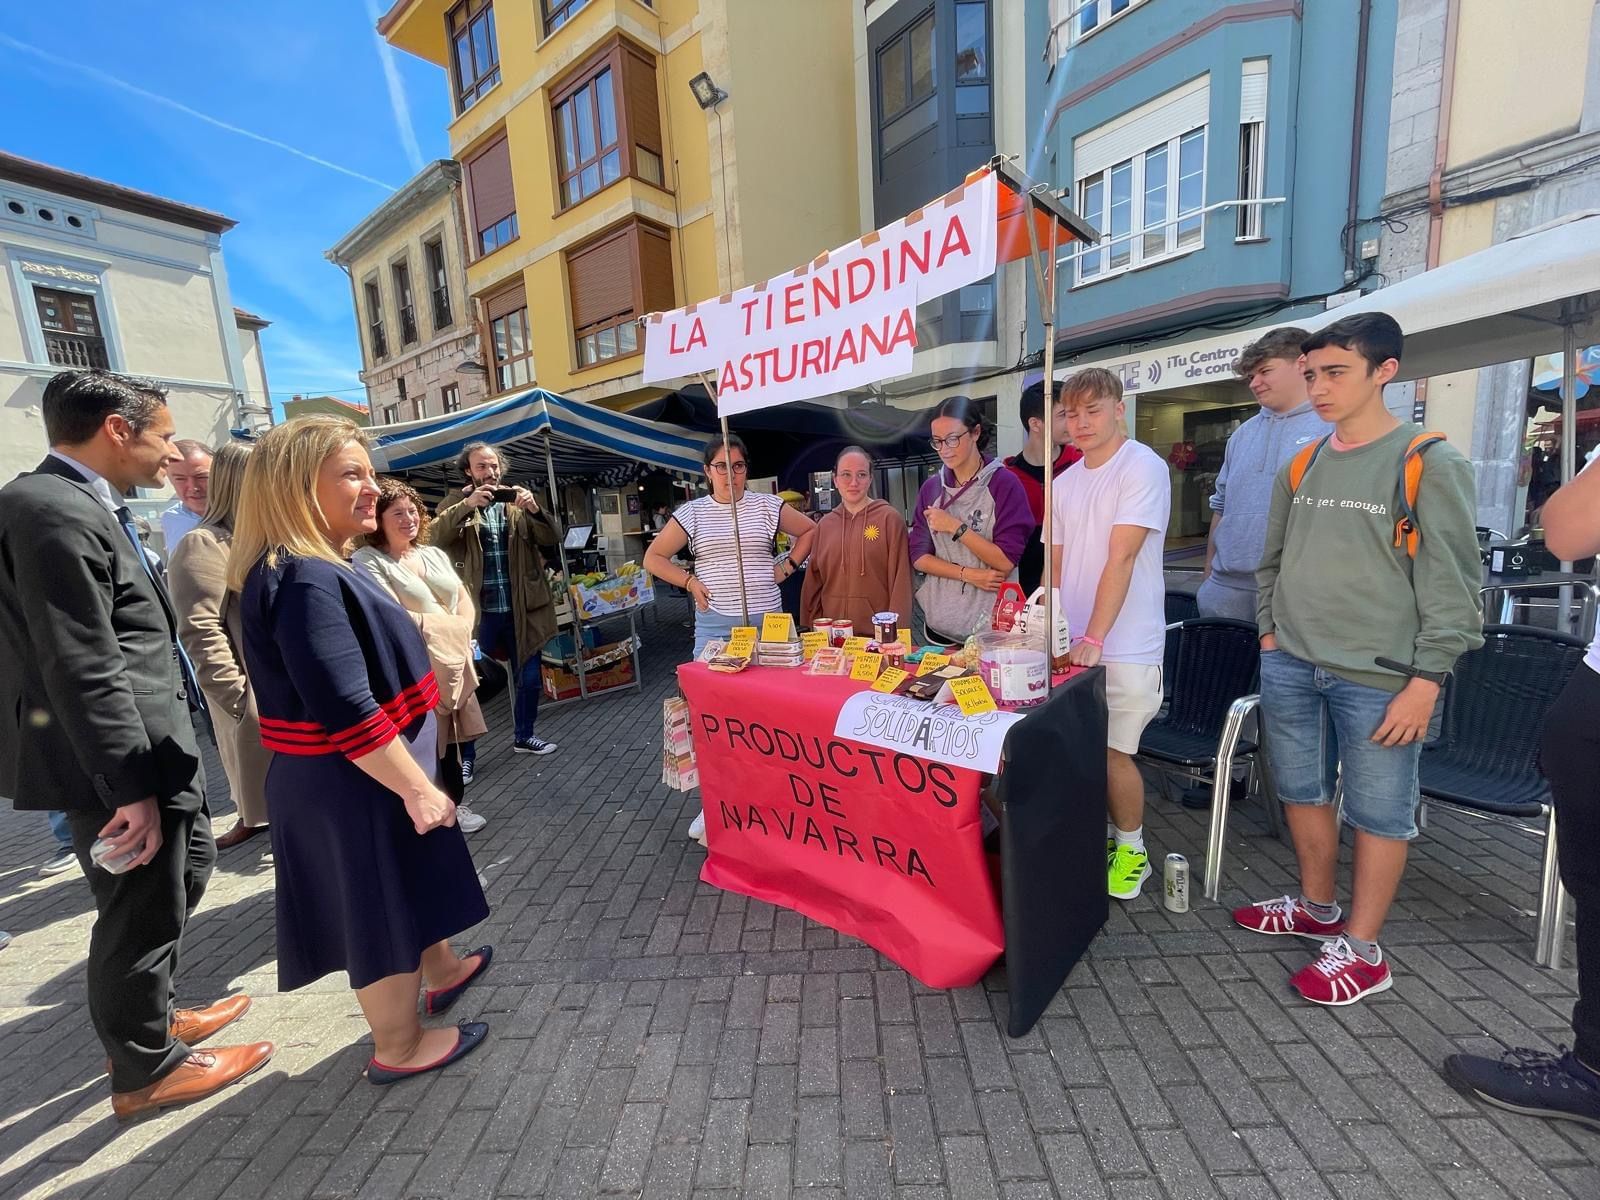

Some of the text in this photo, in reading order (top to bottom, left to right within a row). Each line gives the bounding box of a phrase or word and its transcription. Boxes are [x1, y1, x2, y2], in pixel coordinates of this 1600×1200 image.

[669, 214, 972, 355] LA TIENDINA
[718, 307, 920, 397] ASTURIANA
[1185, 365, 1202, 378] de
[1189, 348, 1239, 364] Centro
[1340, 500, 1386, 515] enough
[700, 713, 958, 808] PRODUCTOS
[788, 774, 846, 819] DE
[720, 801, 936, 888] NAVARRA
